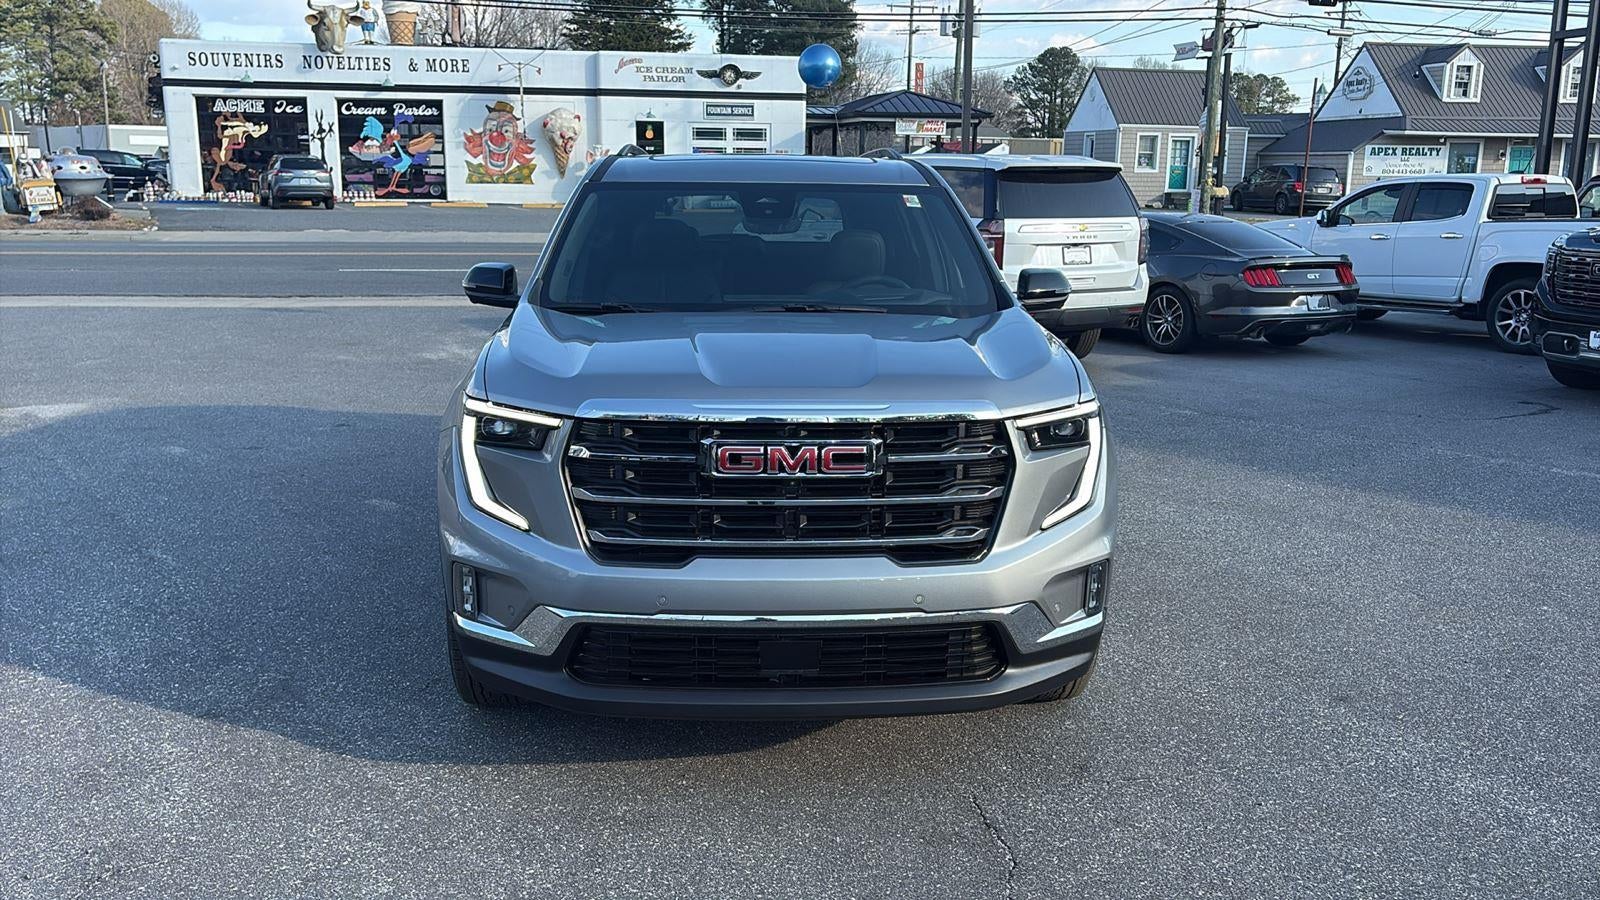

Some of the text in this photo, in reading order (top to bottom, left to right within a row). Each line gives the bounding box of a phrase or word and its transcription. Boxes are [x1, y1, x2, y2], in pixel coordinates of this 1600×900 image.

[187, 51, 470, 73] SOUVENIRS NOVELTIES & MORE
[635, 65, 694, 74] ICE CREAM
[643, 75, 686, 83] PARLOR
[213, 98, 304, 114] ACME Ice
[341, 101, 440, 116] Cream Parlor
[707, 106, 753, 115] FOUNTAIN SERVICE
[1369, 147, 1442, 157] APEX REALTY
[718, 445, 868, 474] GMC
